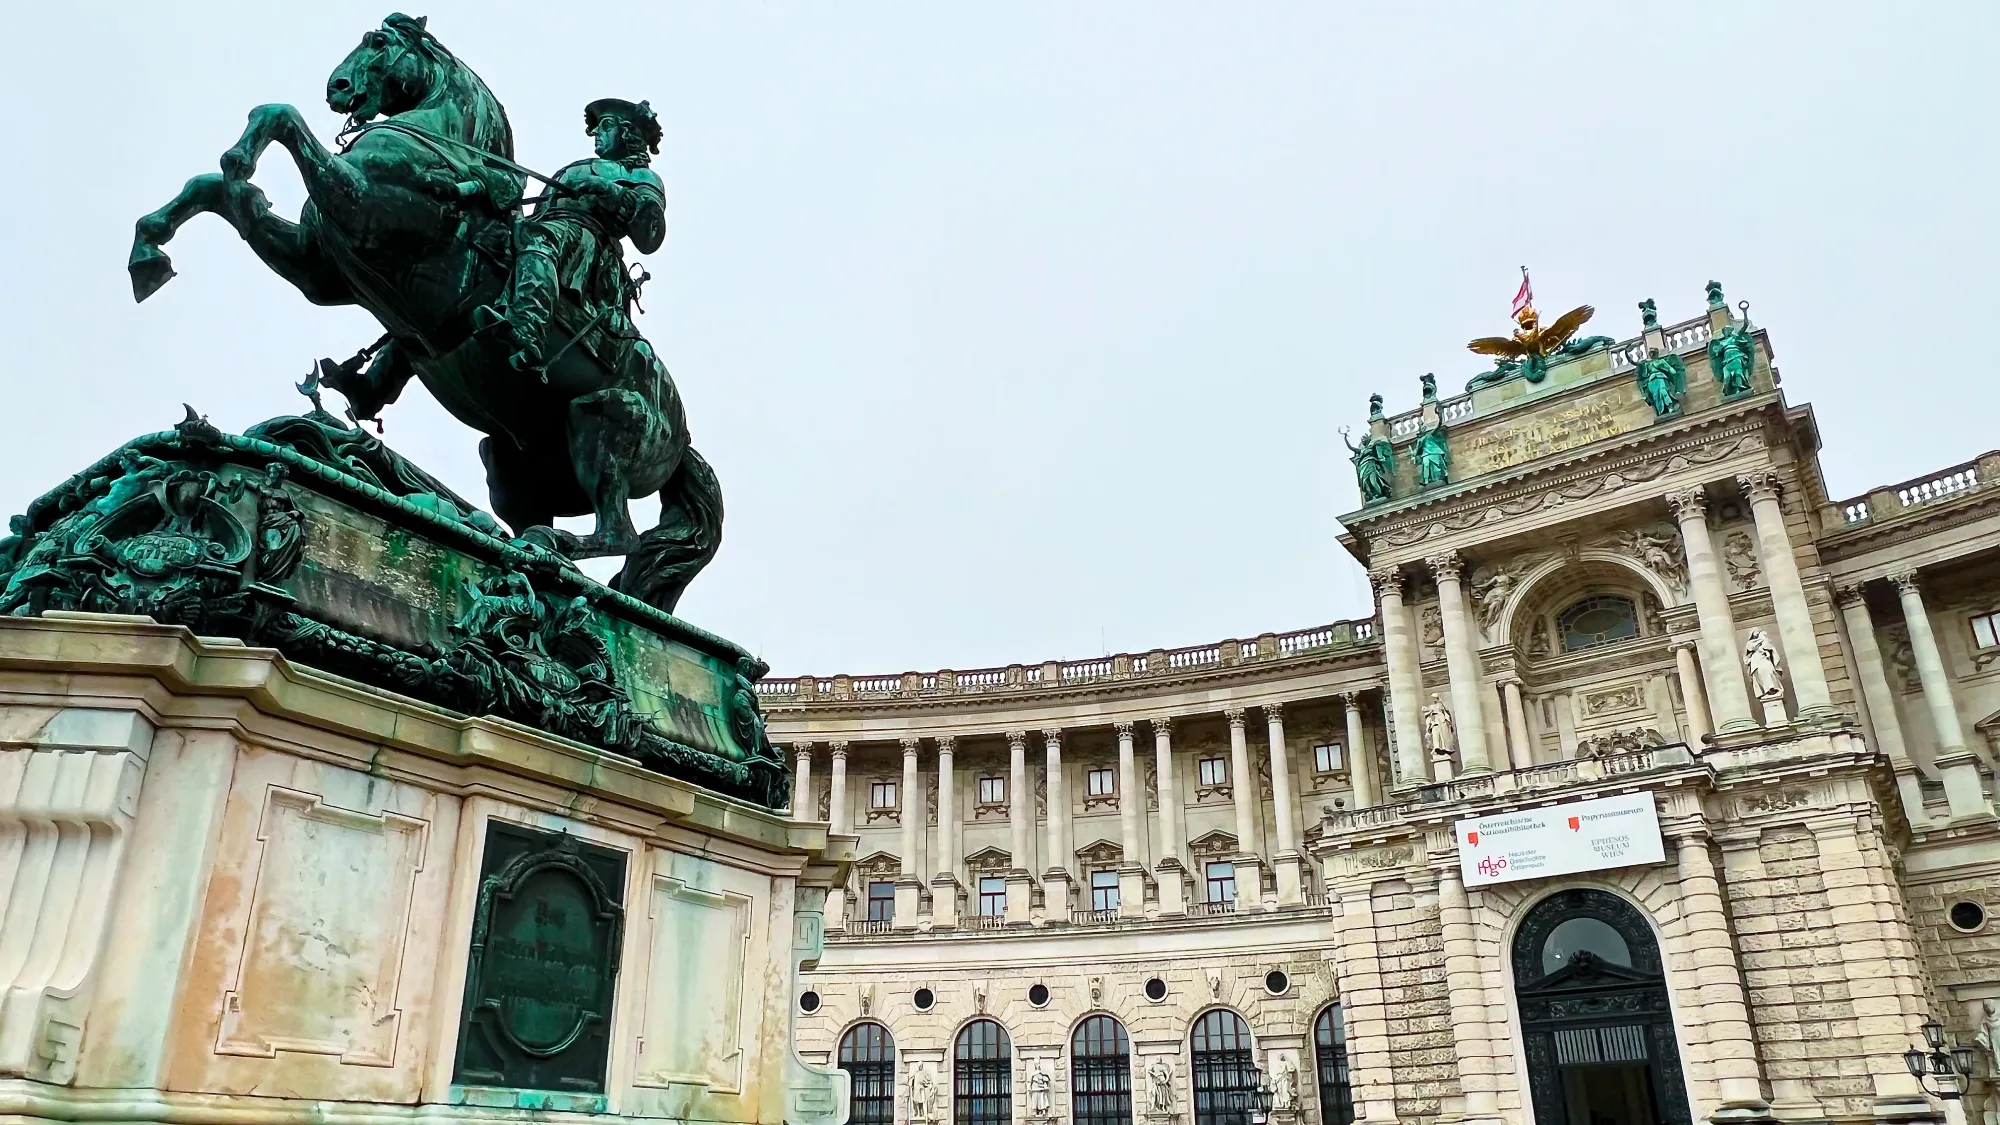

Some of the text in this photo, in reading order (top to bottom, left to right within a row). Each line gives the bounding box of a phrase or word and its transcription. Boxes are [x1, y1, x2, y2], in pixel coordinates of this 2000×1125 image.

[1581, 807, 1644, 821] Papyrusmuseum
[1479, 818, 1533, 830] Österreichische
[1480, 821, 1546, 836] Nationalbibliothek
[1593, 842, 1630, 852] MUSEUM
[1601, 850, 1624, 858] WIEN
[1509, 855, 1546, 865] Geschichte
[1510, 861, 1545, 871] Österreich
